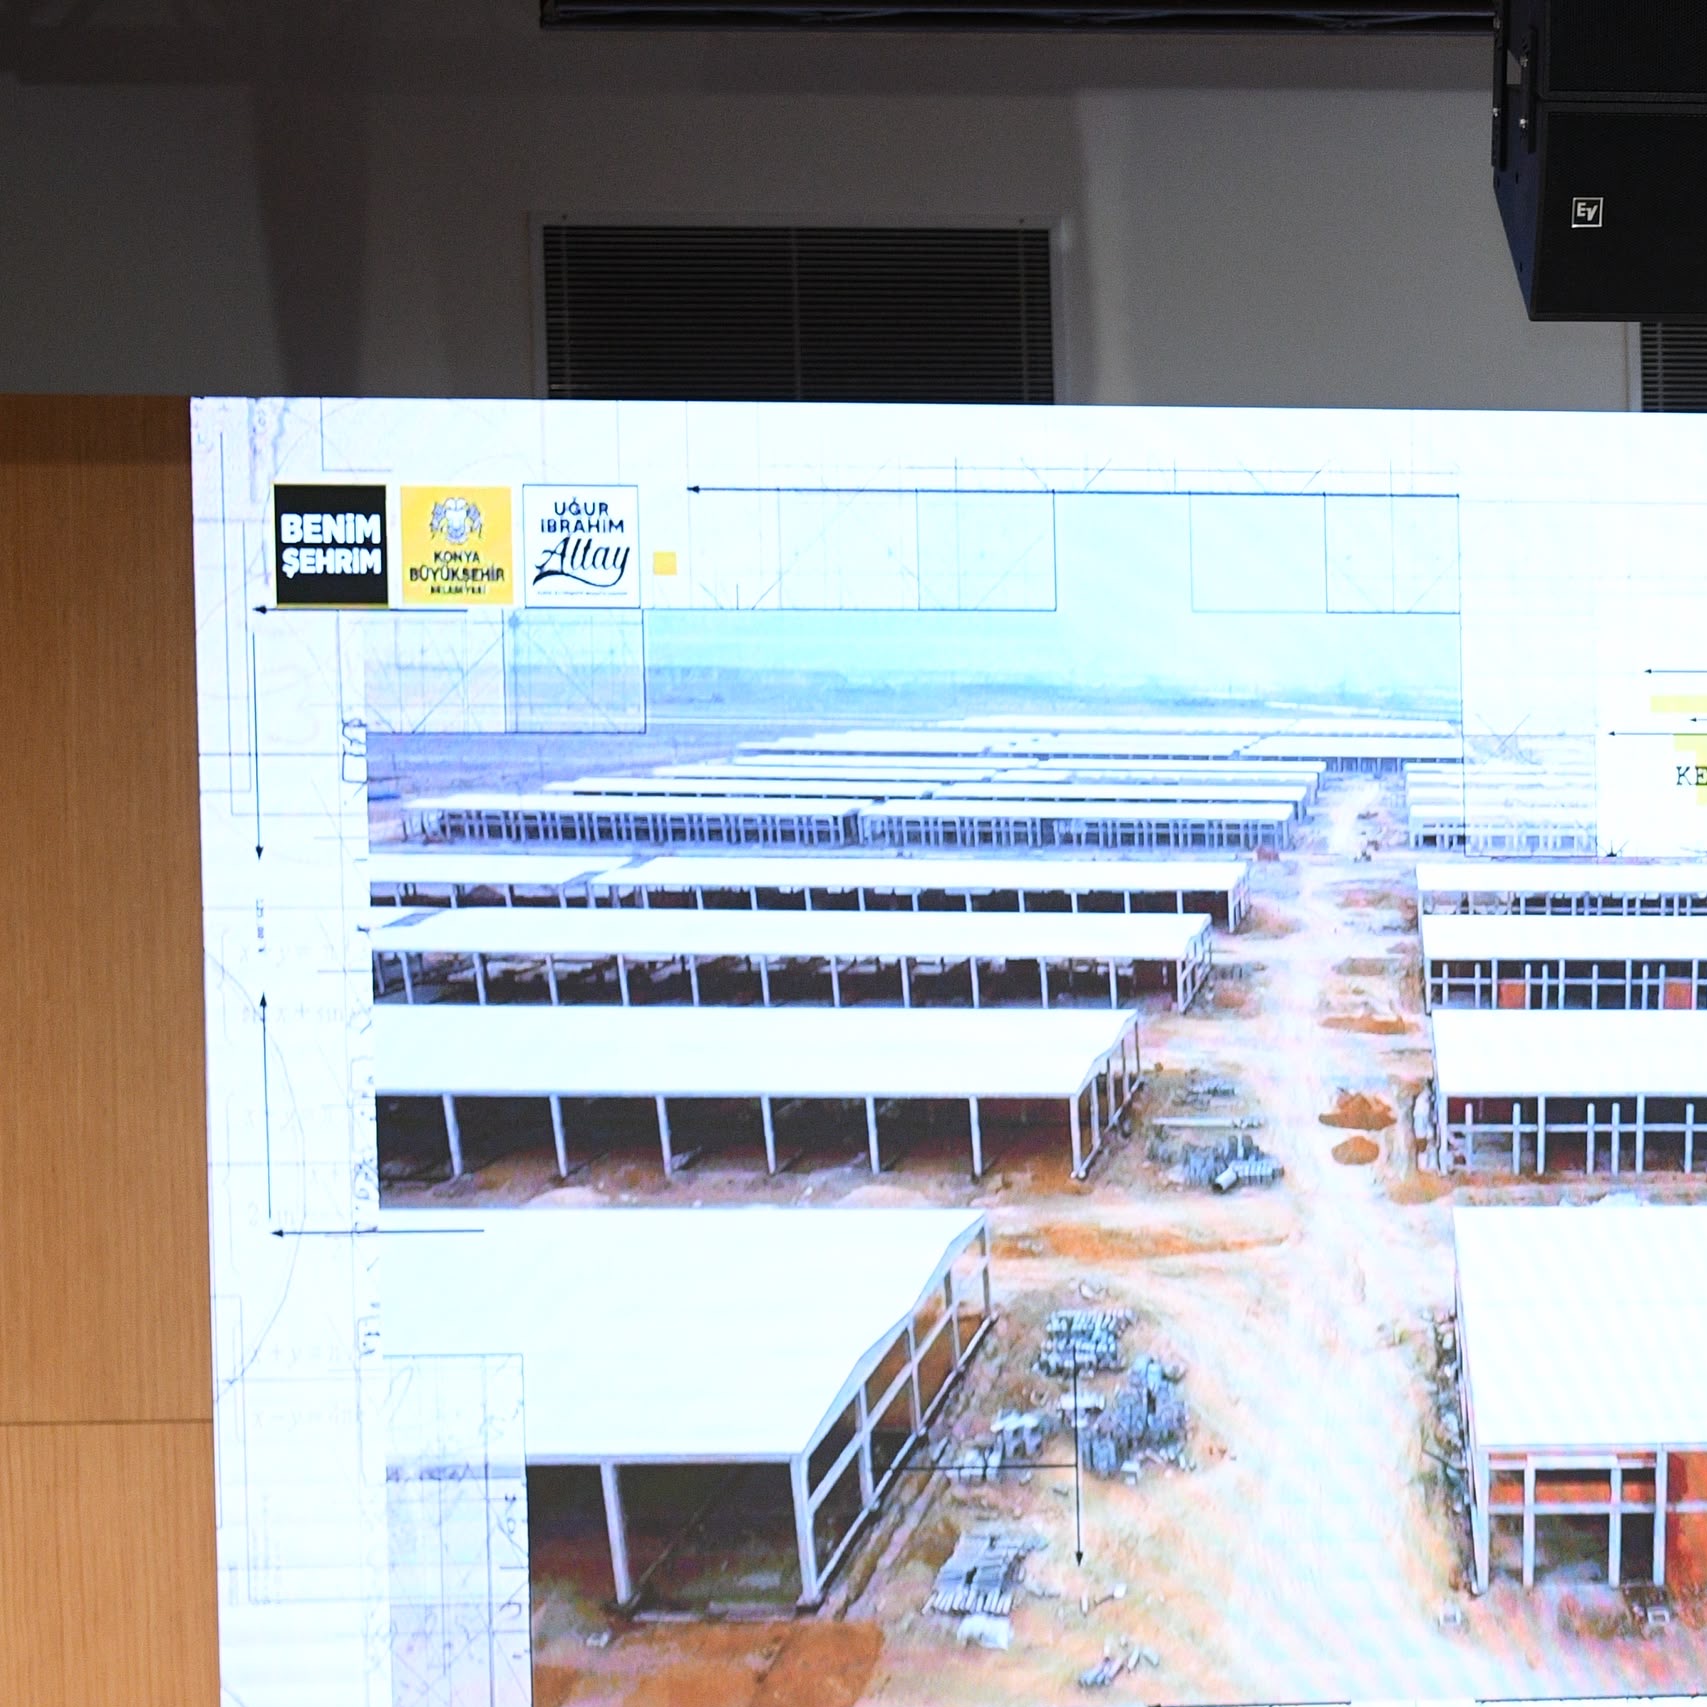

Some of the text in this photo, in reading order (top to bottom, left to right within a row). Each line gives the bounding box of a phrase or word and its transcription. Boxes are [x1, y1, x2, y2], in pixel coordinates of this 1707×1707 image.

[281, 513, 381, 543] BENİM
[282, 547, 382, 579] ŞEHRİM
[434, 551, 480, 563] KONYA
